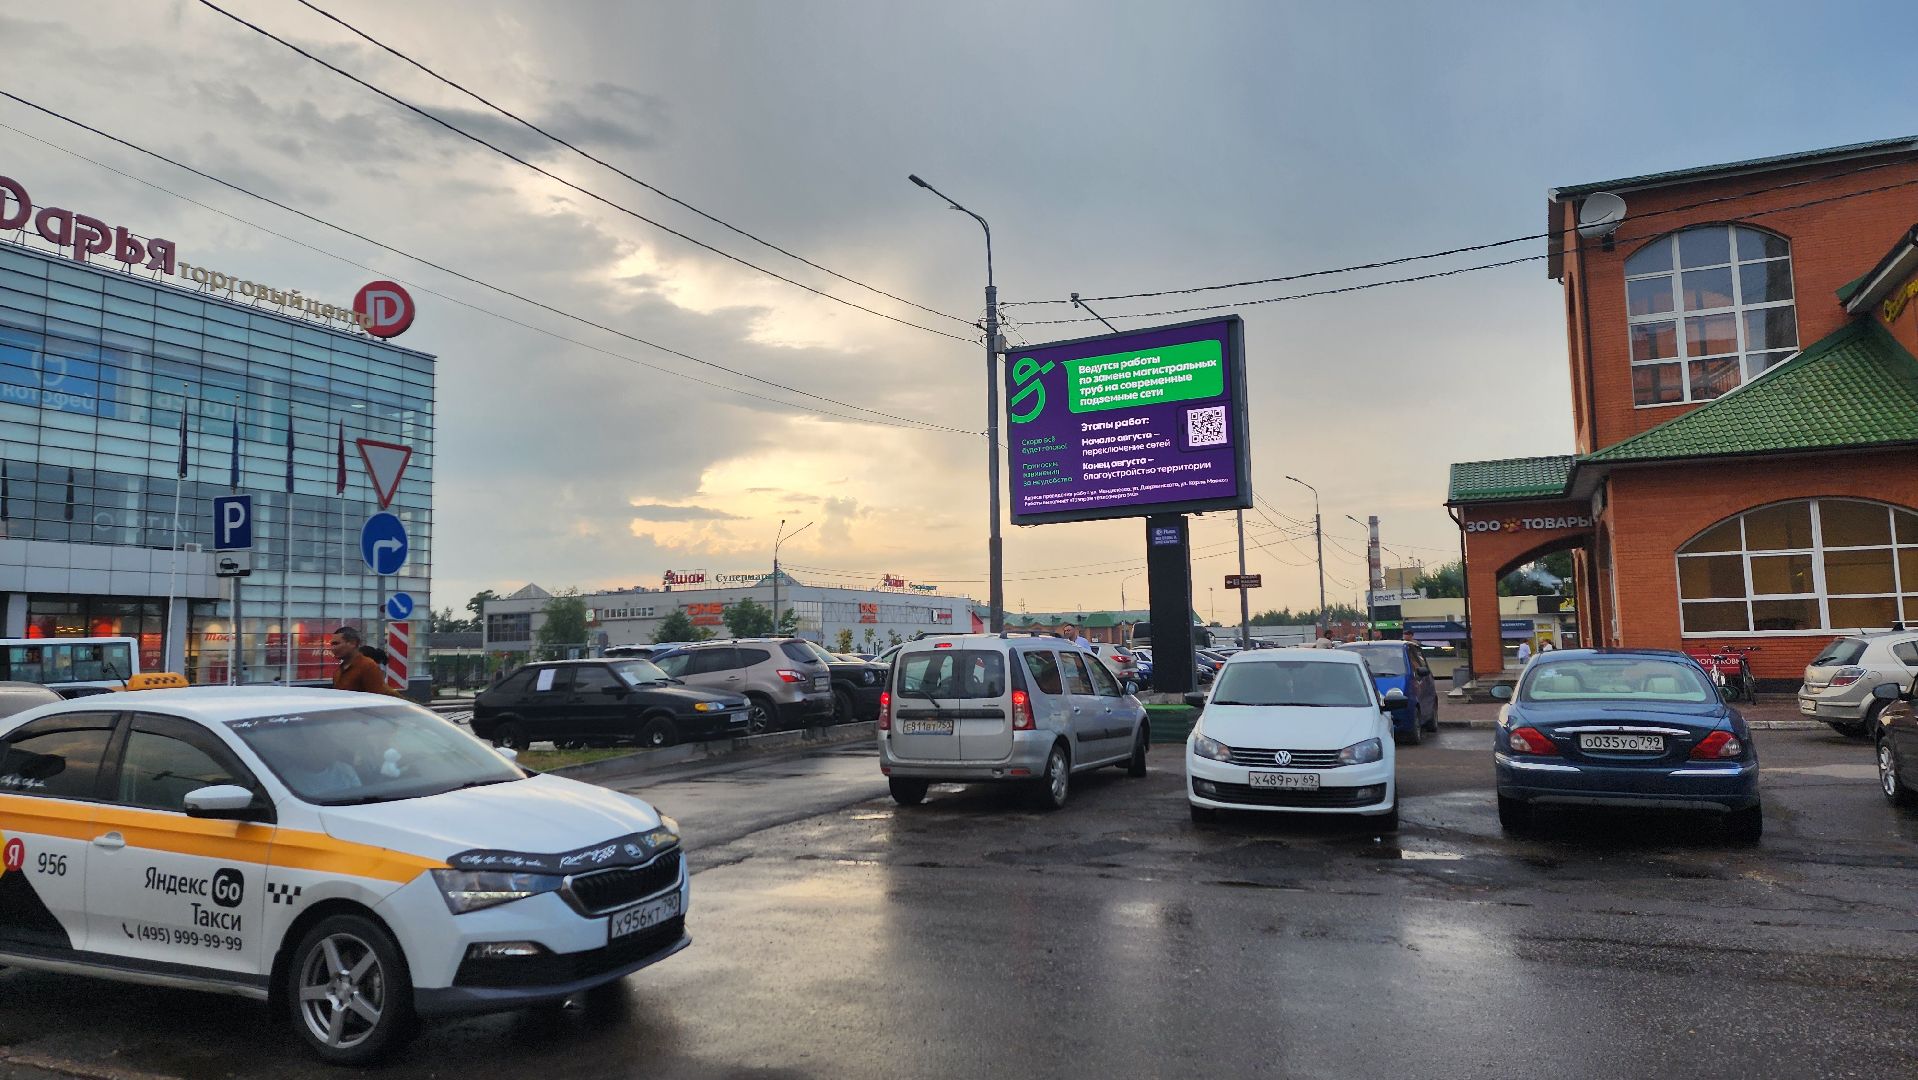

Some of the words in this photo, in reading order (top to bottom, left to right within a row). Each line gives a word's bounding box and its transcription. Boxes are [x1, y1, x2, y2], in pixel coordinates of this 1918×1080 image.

[178, 261, 303, 310] торговый
[307, 298, 374, 331] центр
[1079, 363, 1119, 375] Ведутся
[1121, 356, 1160, 370] работы
[1079, 375, 1092, 385] по
[1093, 372, 1132, 382] замене
[1133, 359, 1217, 378] магистральных
[1080, 384, 1103, 397] труб
[1105, 383, 1119, 392] на
[1120, 373, 1193, 390] современные
[1080, 391, 1139, 406] подземные
[1140, 388, 1164, 398] сети
[1081, 421, 1114, 432] Этапы
[1115, 417, 1149, 430] работ:
[1082, 436, 1116, 446] Начало
[1117, 432, 1153, 442] августа
[1082, 443, 1145, 457] переключение
[1146, 438, 1171, 449] сетей
[1083, 461, 1111, 471] Конец
[1111, 457, 1147, 468] августа
[1083, 468, 1157, 480] благоустройство
[1157, 462, 1211, 474] территории
[223, 501, 246, 544] P
[1467, 521, 1501, 532] ЗОО
[1522, 516, 1594, 530] ТОВАРЫ
[1639, 736, 1660, 746] 799
[1303, 774, 1315, 784] 69
[8, 844, 20, 867] Я
[37, 852, 67, 876] 956
[144, 866, 208, 896] Яндекс
[214, 873, 243, 901] Go
[190, 902, 242, 932] Такси
[137, 923, 171, 944] (495)
[174, 928, 243, 951] 999-99-99
